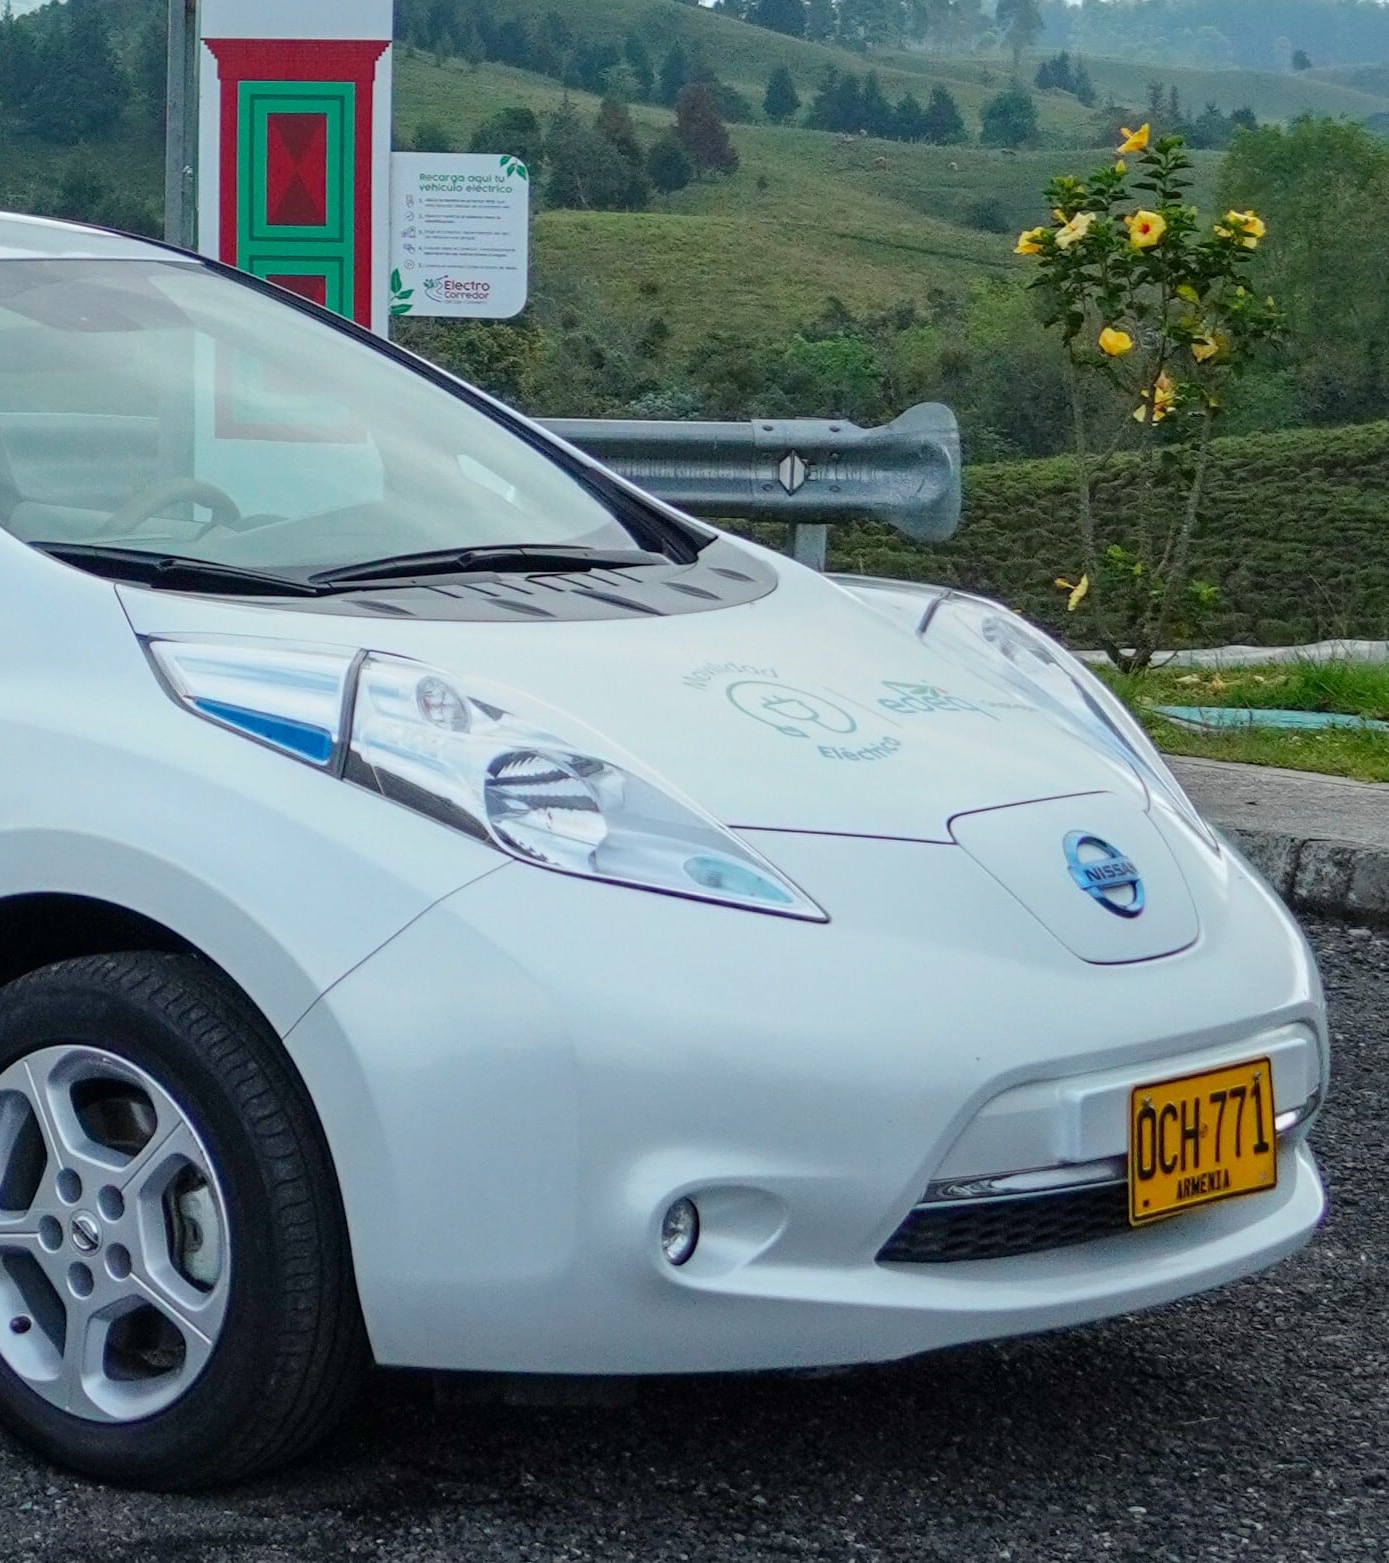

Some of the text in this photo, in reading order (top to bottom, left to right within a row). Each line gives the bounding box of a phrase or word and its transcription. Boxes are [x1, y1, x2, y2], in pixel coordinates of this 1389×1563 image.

[419, 173, 465, 184] Recarga
[495, 174, 505, 183] tu
[444, 280, 490, 291] Electro
[444, 290, 490, 300] Corredor
[878, 680, 1001, 721] edeq
[1083, 861, 1137, 881] NISSAN
[1137, 1074, 1269, 1181] OCH 771
[1177, 1168, 1231, 1200] ARMENIA
